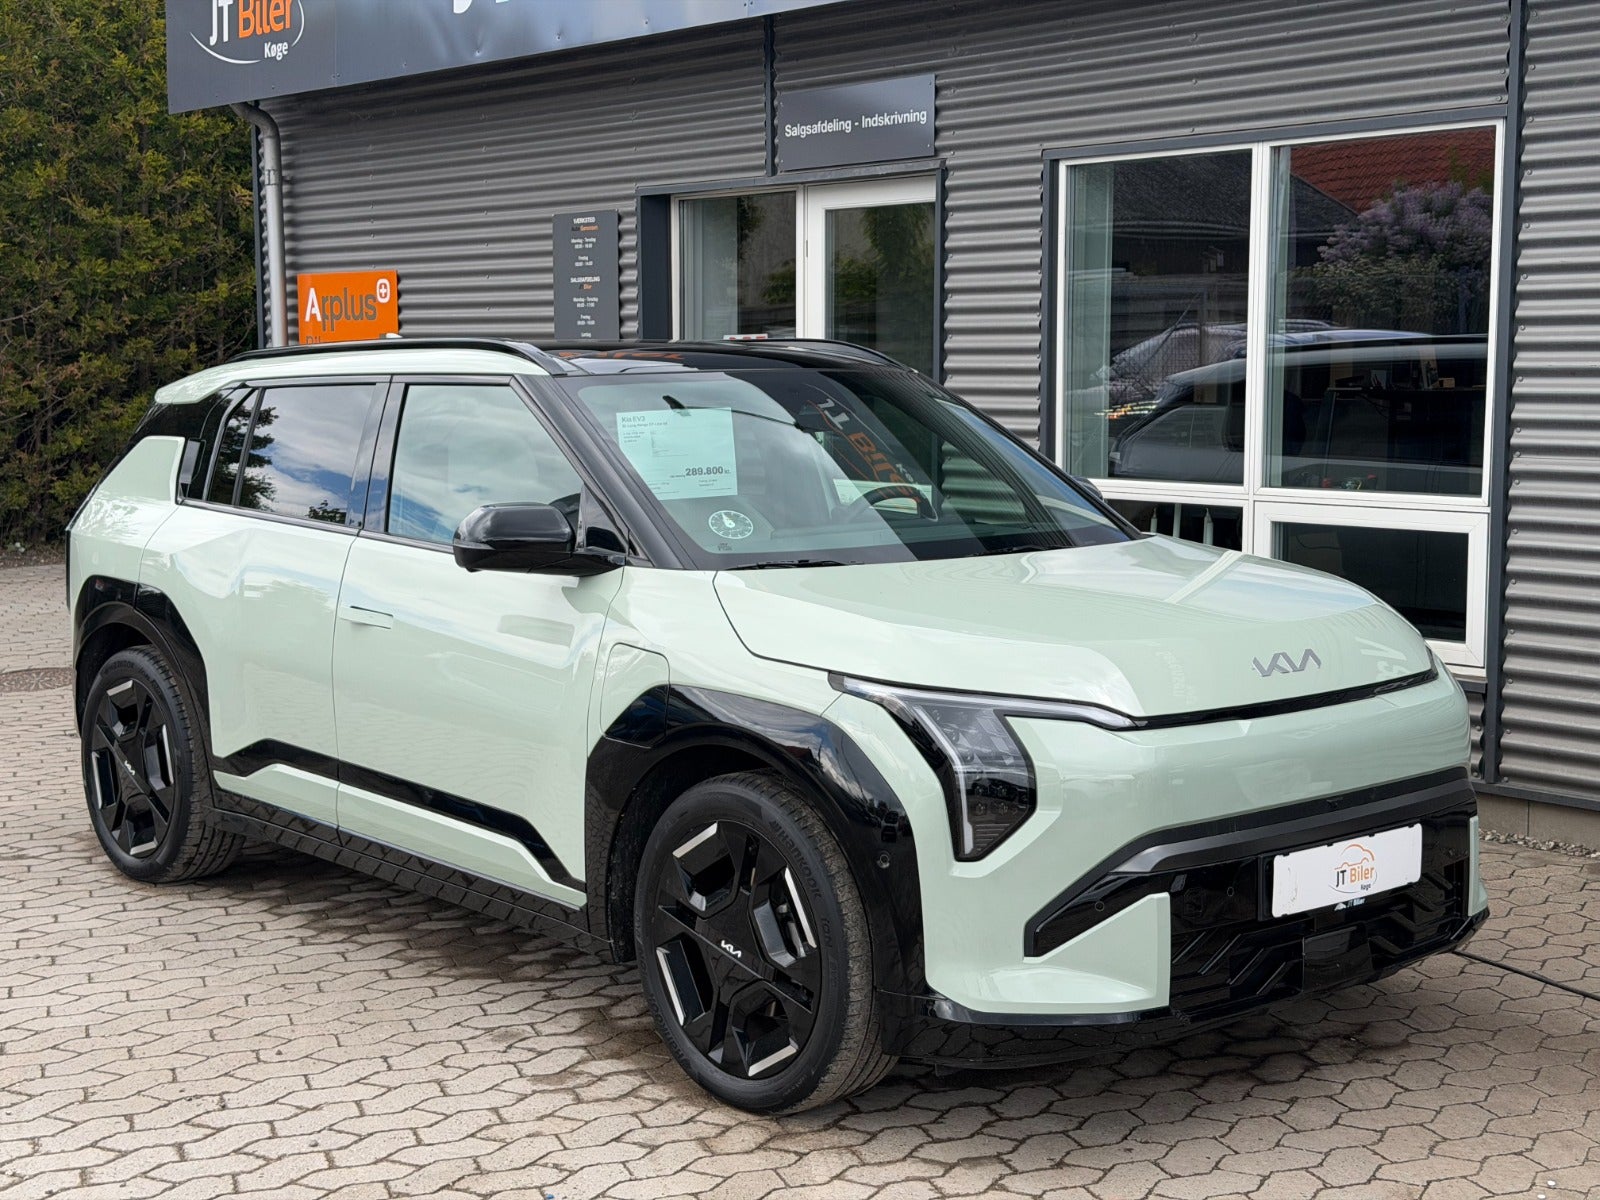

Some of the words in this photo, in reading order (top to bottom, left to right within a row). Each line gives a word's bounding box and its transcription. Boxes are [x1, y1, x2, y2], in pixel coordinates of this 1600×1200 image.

[209, 0, 234, 46] JT
[238, 0, 293, 38] Biler
[264, 41, 289, 61] Køge
[784, 118, 852, 138] Salgsafdeling
[861, 109, 927, 129] Indskrivning
[685, 466, 724, 477] 289.800
[1251, 648, 1322, 678] KIA
[1335, 869, 1347, 888] JT
[1349, 866, 1375, 883] Biler
